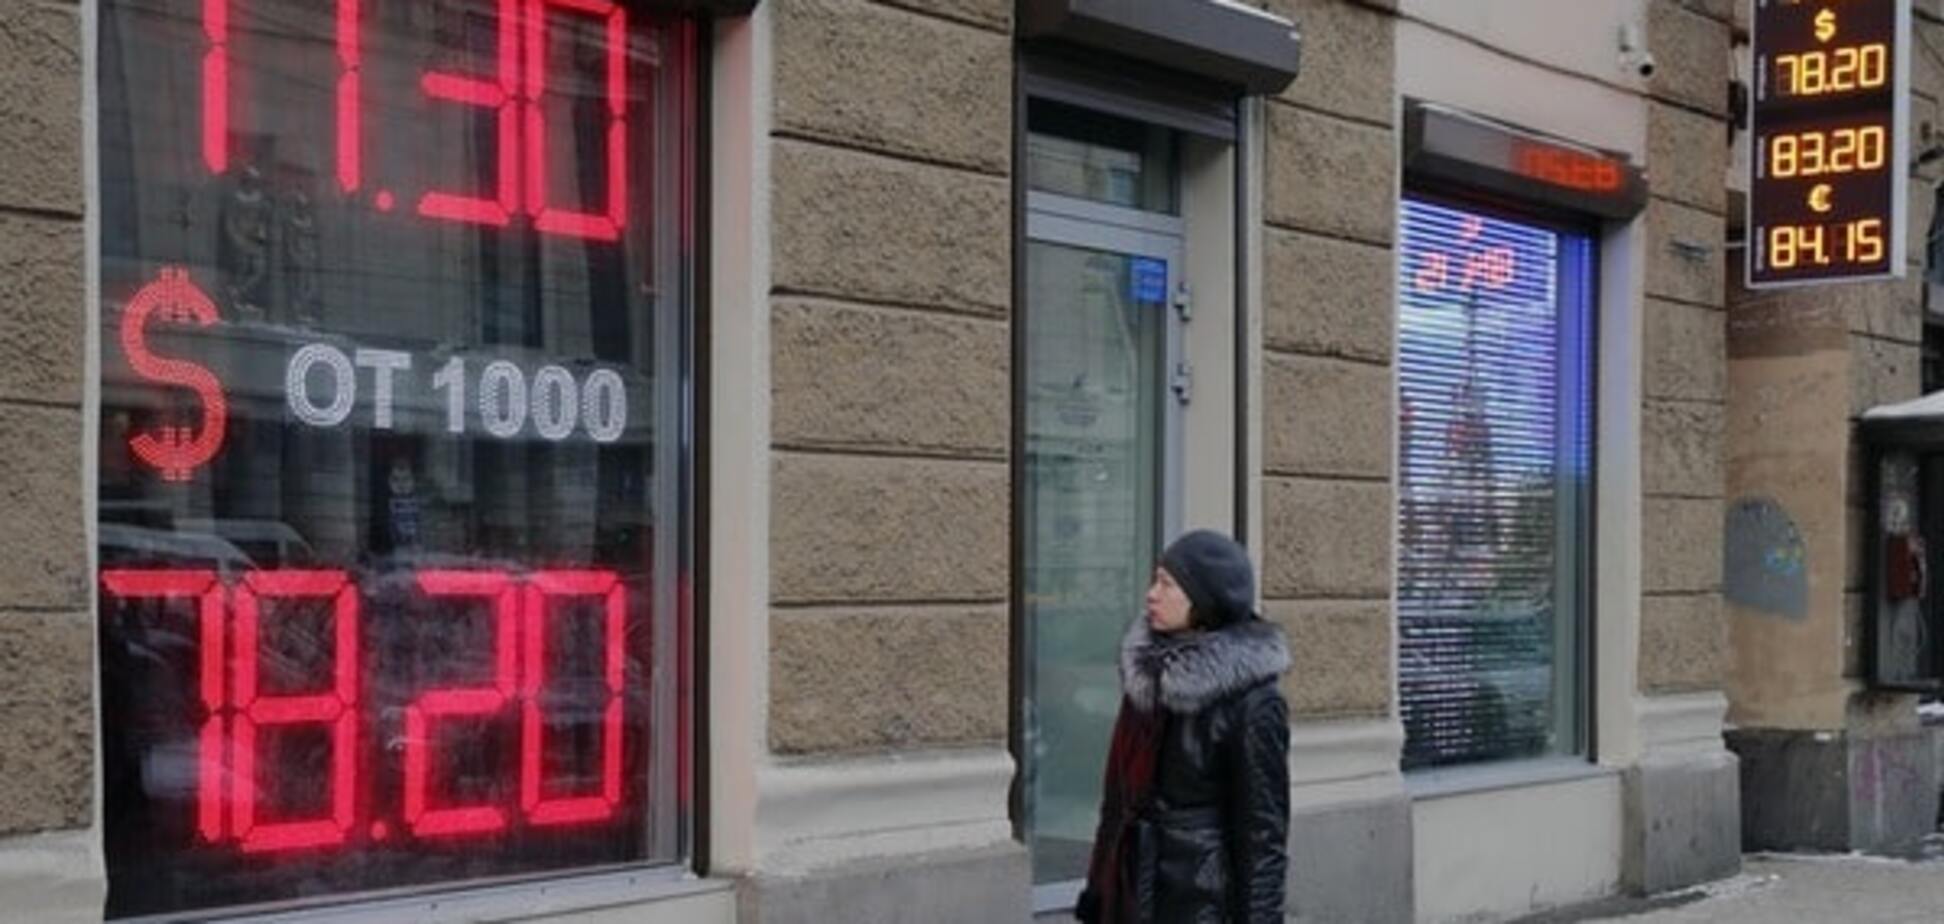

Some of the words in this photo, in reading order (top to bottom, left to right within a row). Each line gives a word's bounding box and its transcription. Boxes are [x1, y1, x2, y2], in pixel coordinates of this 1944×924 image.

[1814, 8, 1836, 42] $
[1775, 44, 1886, 95] 78.20
[1771, 126, 1885, 178] 83.20
[1808, 184, 1832, 212] €
[1769, 218, 1883, 268] 84.15
[120, 265, 227, 481] $
[285, 342, 412, 430] ОТ
[432, 356, 628, 443] 1000
[102, 570, 626, 853] 78.20
